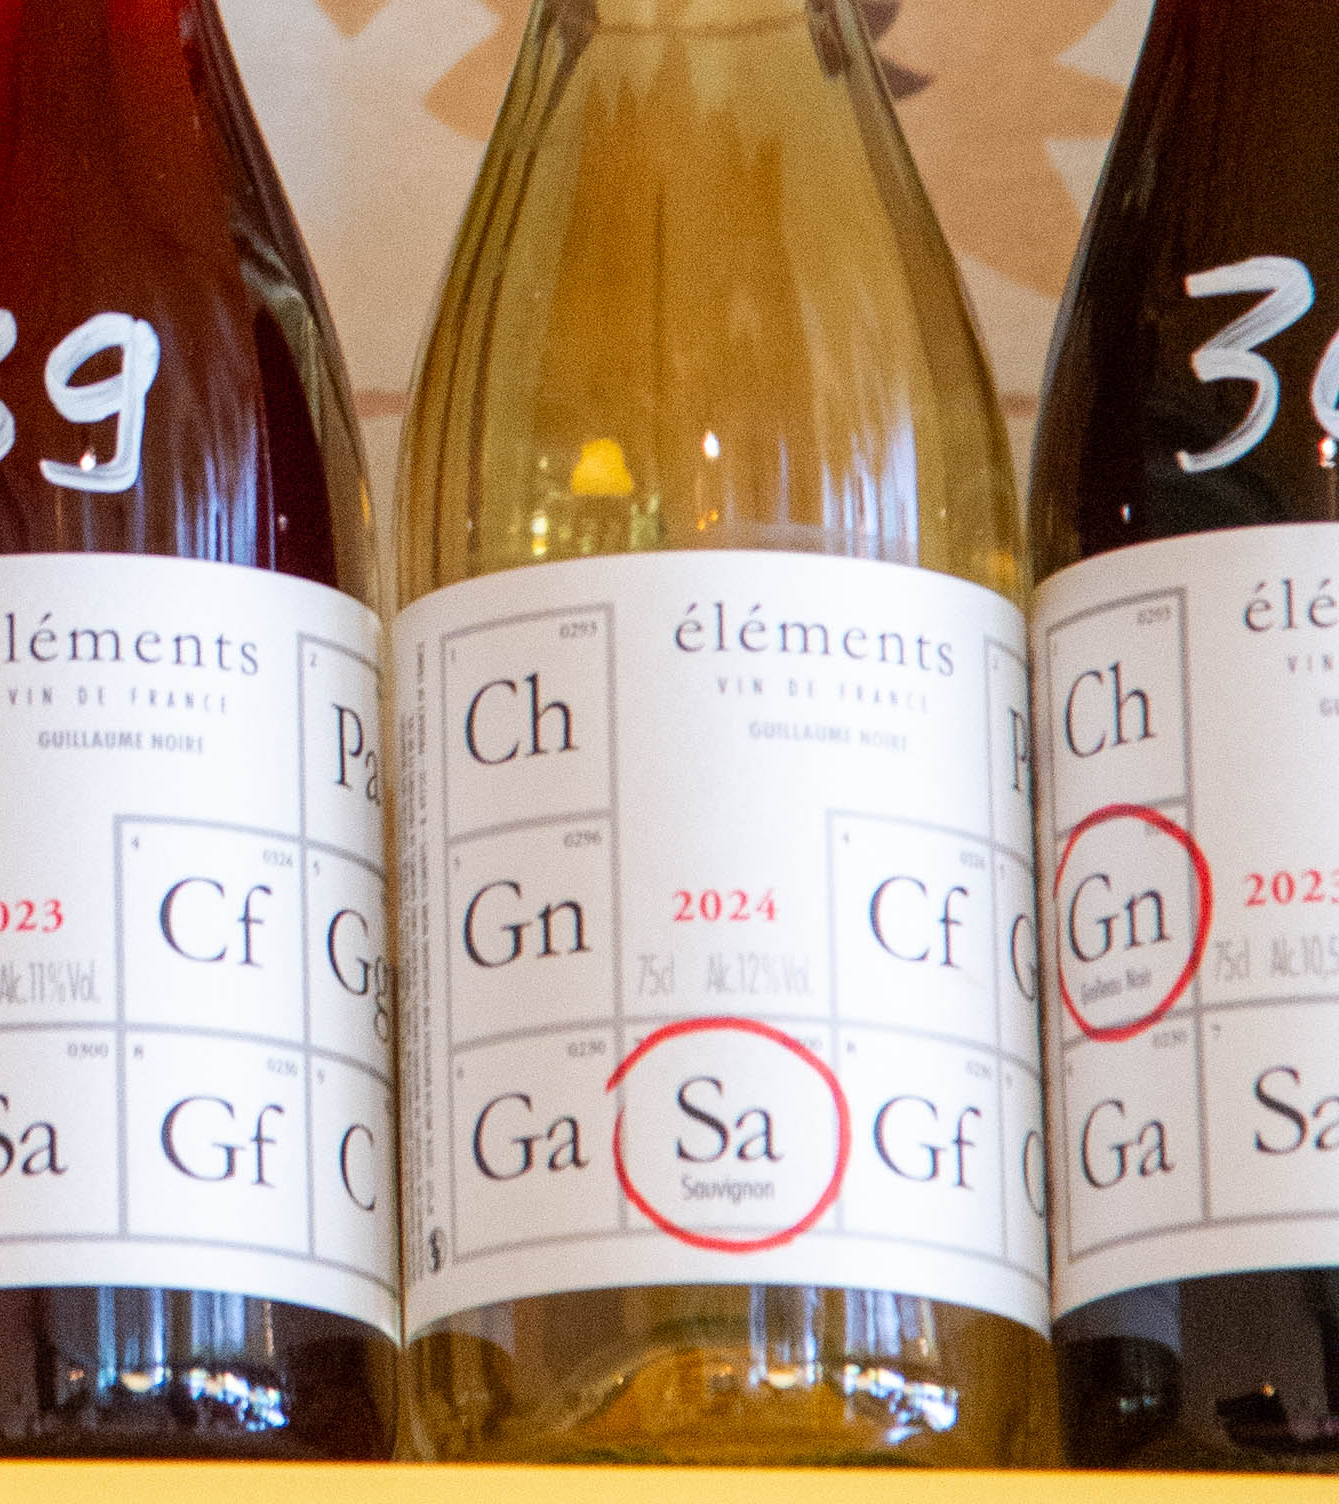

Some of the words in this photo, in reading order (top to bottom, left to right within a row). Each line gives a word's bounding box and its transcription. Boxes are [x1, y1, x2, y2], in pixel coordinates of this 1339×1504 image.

[674, 601, 956, 678] éléments
[8, 687, 53, 706] VIN
[78, 686, 107, 706] DE
[129, 686, 228, 715] FRANCE
[38, 727, 144, 752] GUILLAUME
[465, 671, 580, 766] Ch
[717, 676, 765, 696] VIN
[787, 676, 816, 699] DE
[839, 682, 929, 714] FRANCE
[1064, 660, 1158, 760] Ch
[159, 875, 273, 969] Cf
[462, 878, 593, 970] Gn
[672, 887, 778, 924] 2024
[869, 874, 971, 970] Cf
[1068, 870, 1172, 964] Gn
[160, 1094, 285, 1189] Gf
[472, 1091, 591, 1182] Ga
[675, 1074, 785, 1164] Sa
[872, 1093, 983, 1192] Gf
[1080, 1097, 1176, 1190] Ga
[680, 1175, 776, 1206] Sauvignon
